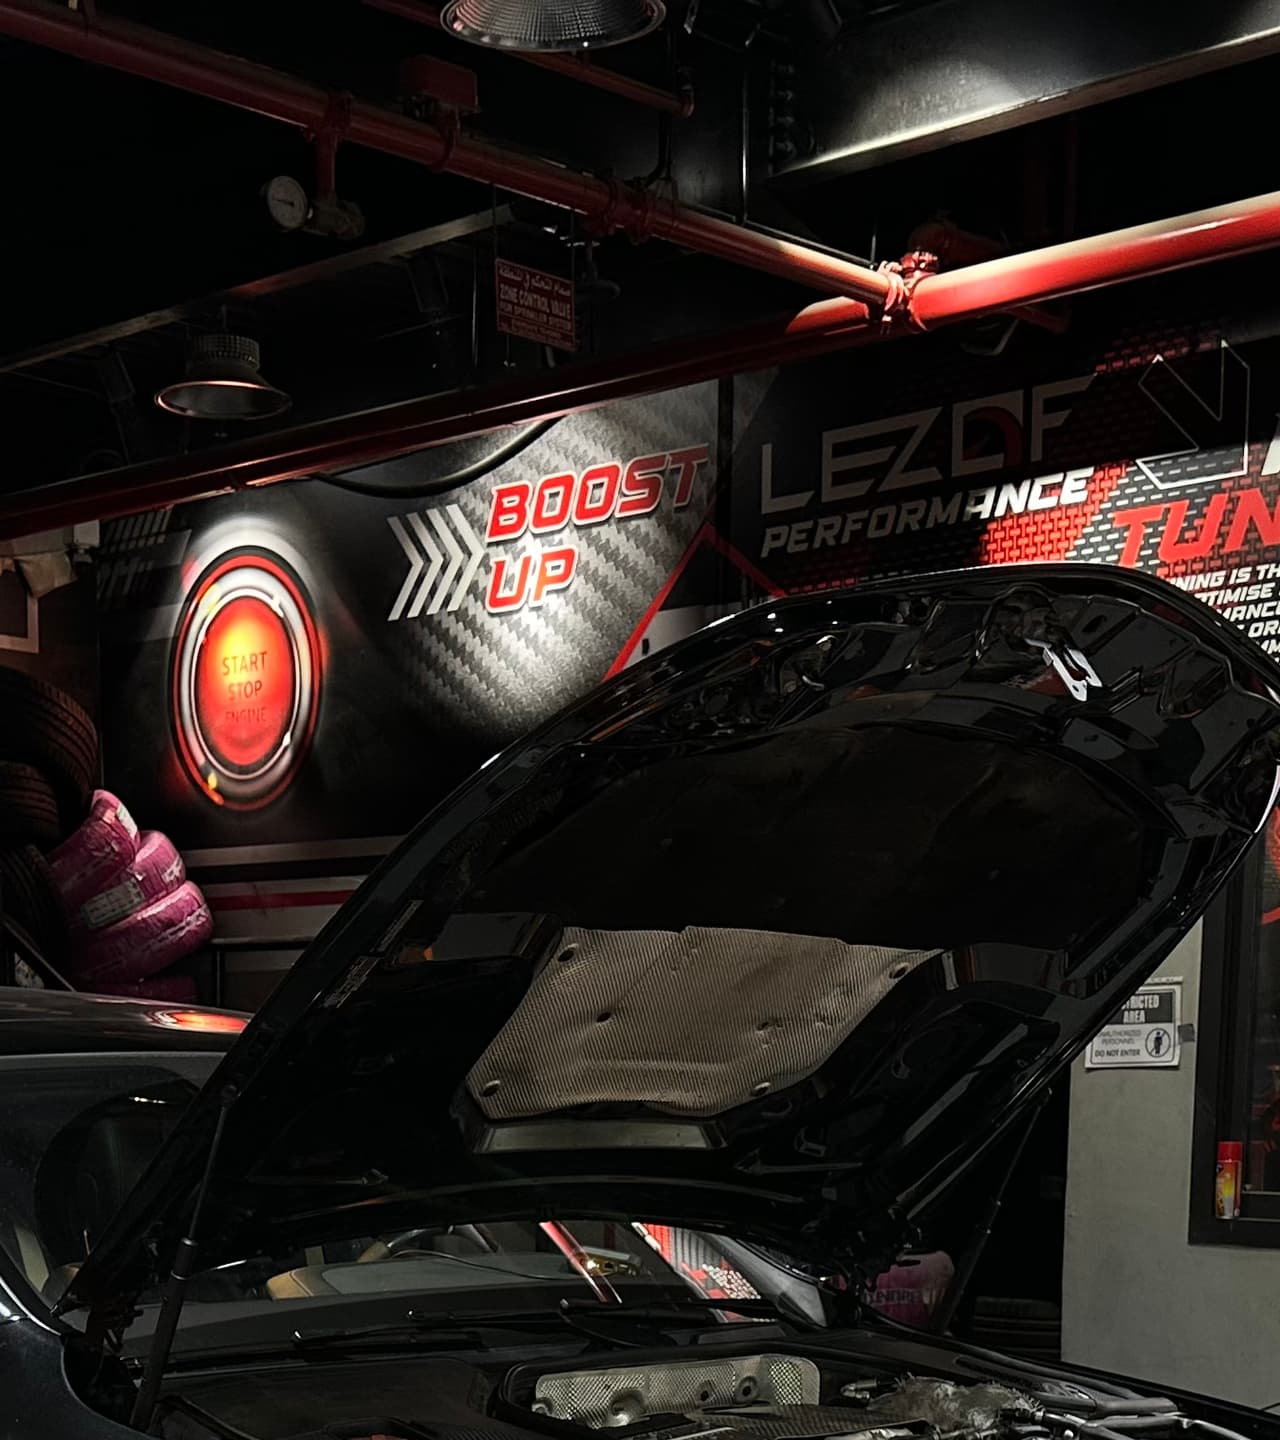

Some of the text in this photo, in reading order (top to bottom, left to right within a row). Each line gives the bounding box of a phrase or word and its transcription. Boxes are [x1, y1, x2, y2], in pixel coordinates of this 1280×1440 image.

[519, 290, 549, 314] CONTROL
[485, 443, 708, 543] BOOST
[760, 466, 1095, 558] PERFORMANCE
[485, 548, 578, 613] UP
[1229, 567, 1252, 584] IS
[222, 651, 267, 675] START
[228, 680, 262, 700] STOP
[226, 707, 267, 722] ENGINE
[1106, 1049, 1120, 1057] NOT
[1121, 1048, 1141, 1057] ENTER
